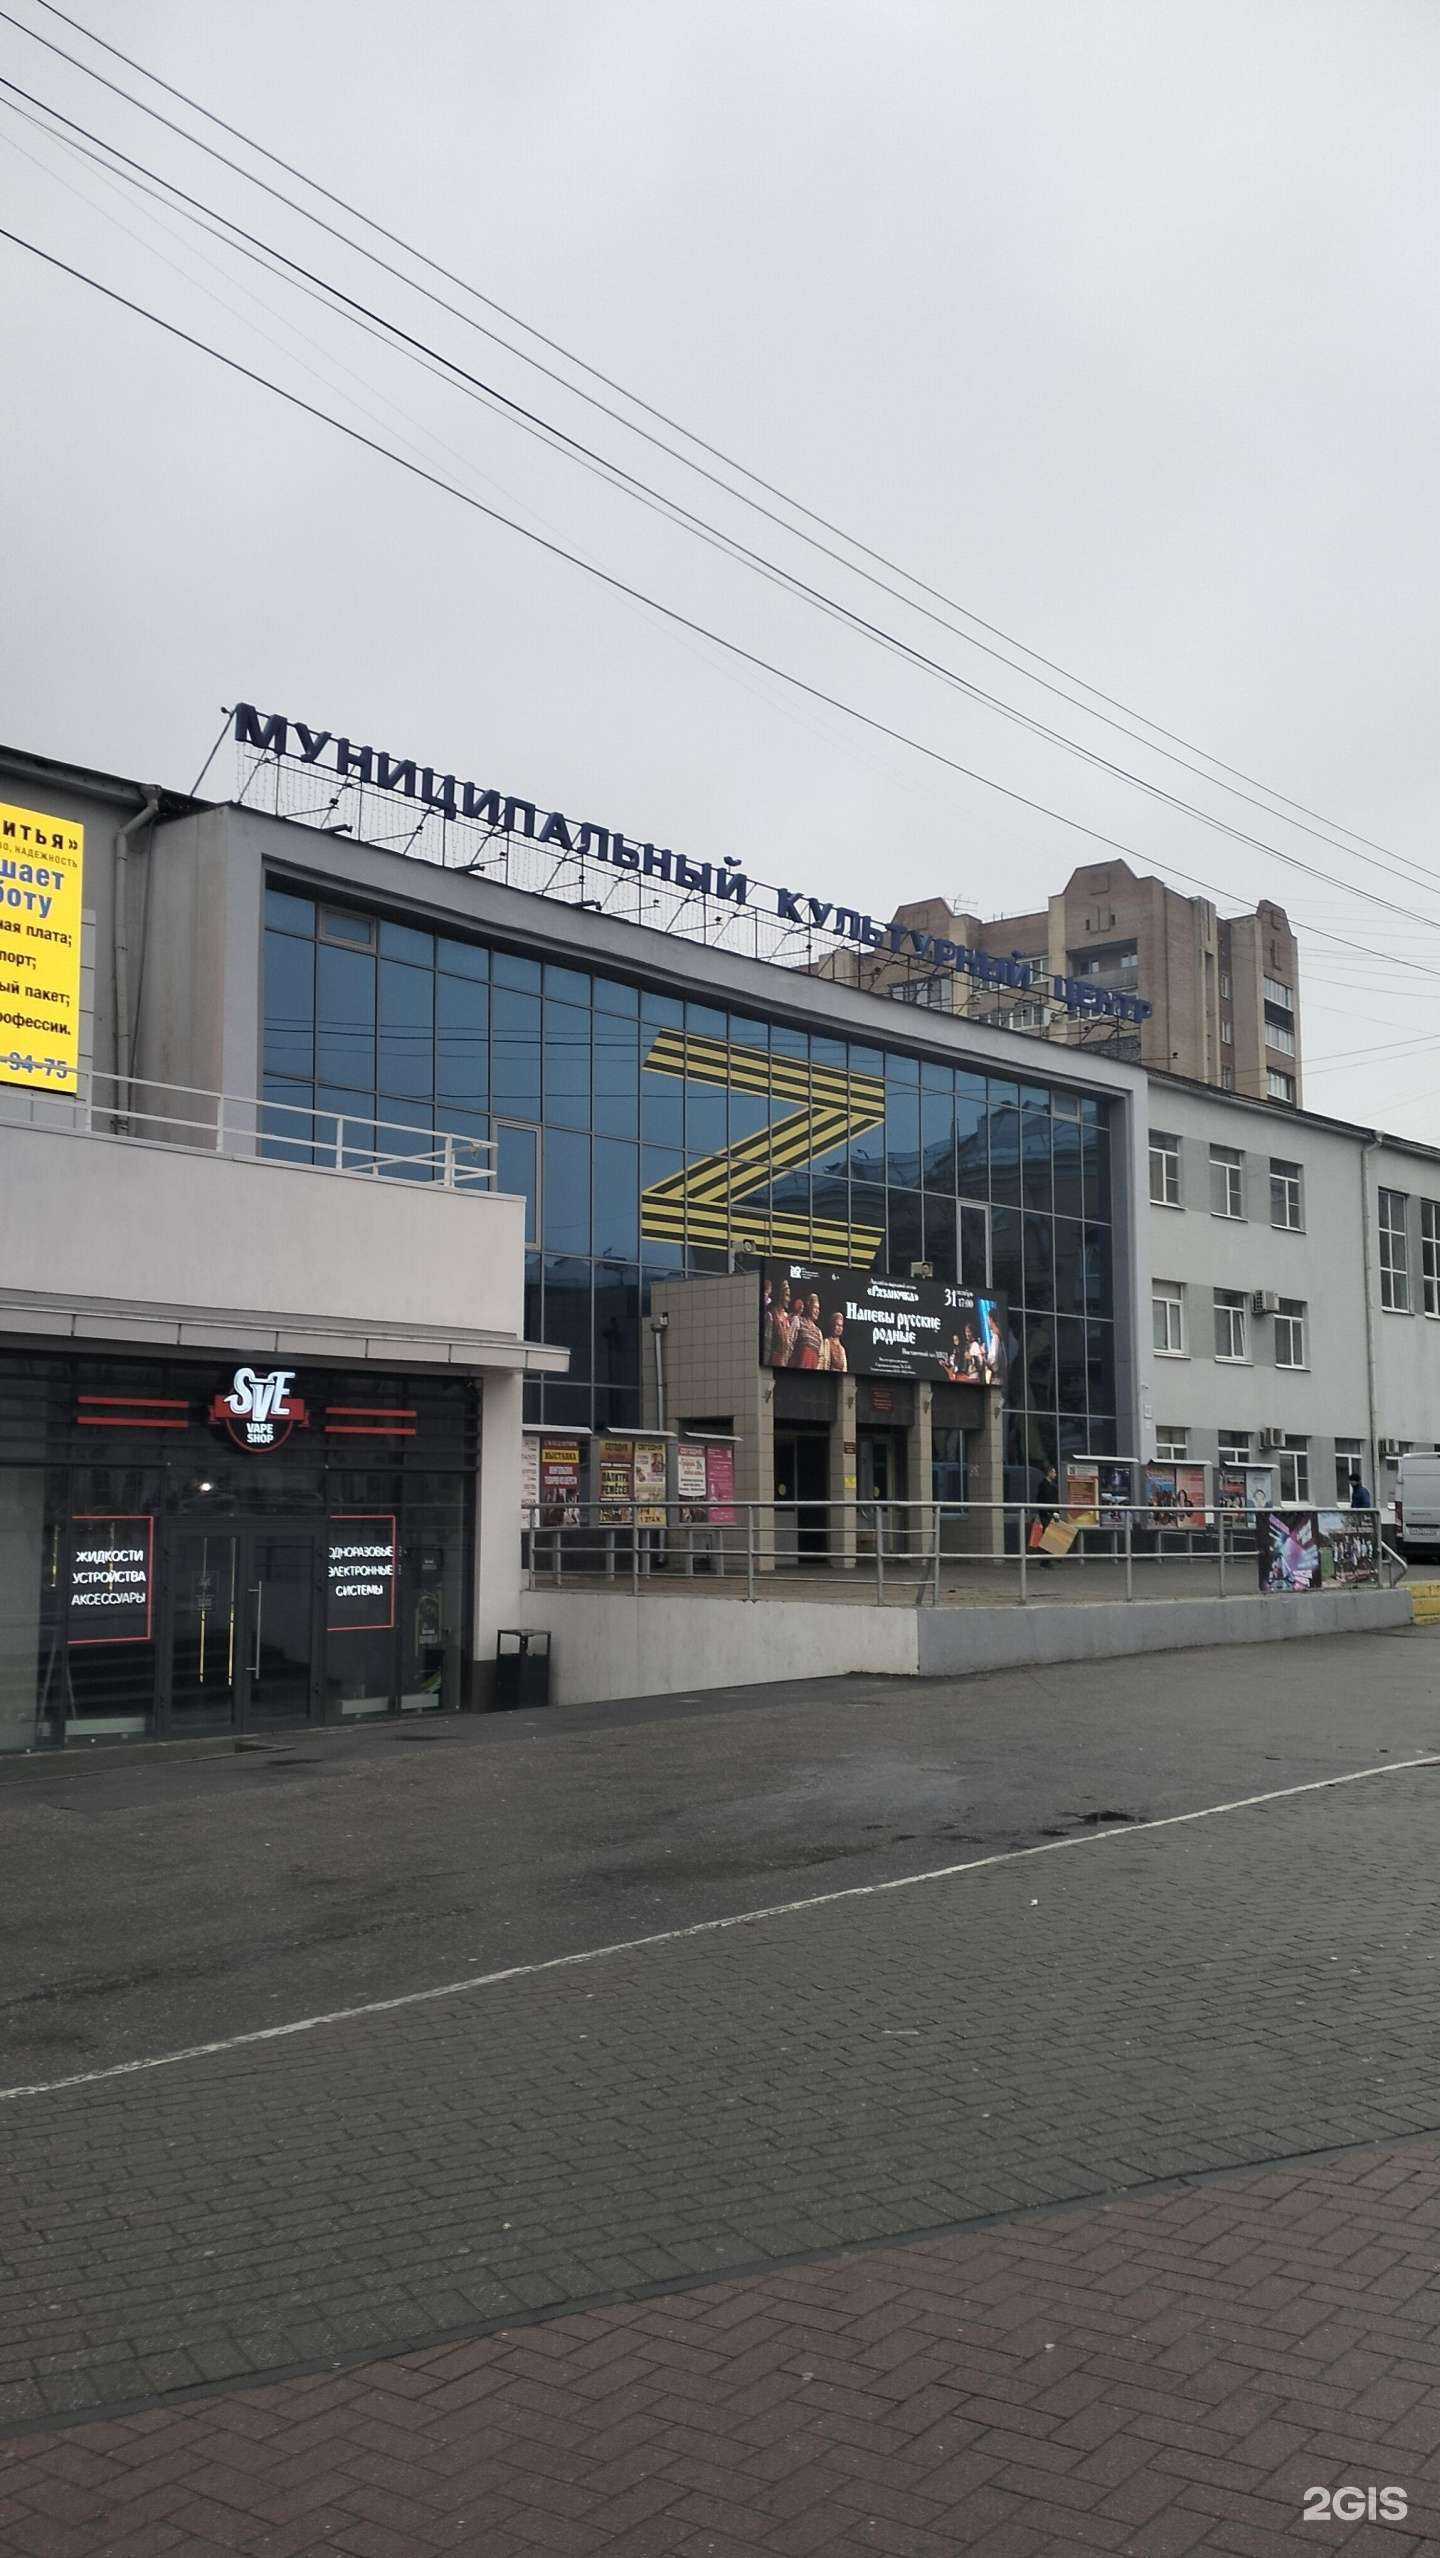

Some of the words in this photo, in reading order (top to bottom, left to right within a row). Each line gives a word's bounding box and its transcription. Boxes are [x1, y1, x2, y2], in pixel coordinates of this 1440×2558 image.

[15, 845, 78, 868] НАДЕЖНОСТЬ
[235, 702, 747, 904] МУНИЦИПАЛЬНЫЙ
[778, 888, 1030, 989] КУЛЬТУРНЫЙ
[1054, 975, 1153, 1023] ЦЕНТР
[26, 925, 72, 948] плата;
[25, 986, 70, 1007] пакет;
[944, 1288, 958, 1308] 31
[845, 1301, 895, 1325] Напевы
[897, 1312, 942, 1333] русские
[872, 1327, 917, 1346] родные
[223, 1367, 296, 1422] SVE
[246, 1422, 274, 1434] VAPE
[246, 1433, 274, 1444] SHOP
[76, 1550, 144, 1564] ЖИДКОСТИ
[328, 1545, 394, 1560] ОДНОРАЗОВЫЕ
[72, 1569, 147, 1584] УСТРОЙСТВА
[328, 1564, 394, 1577] ЭЛЕКТРОННЫЕ
[71, 1592, 146, 1606] АКСЕССУАРЫ
[335, 1584, 384, 1597] СИСТЕМЫ
